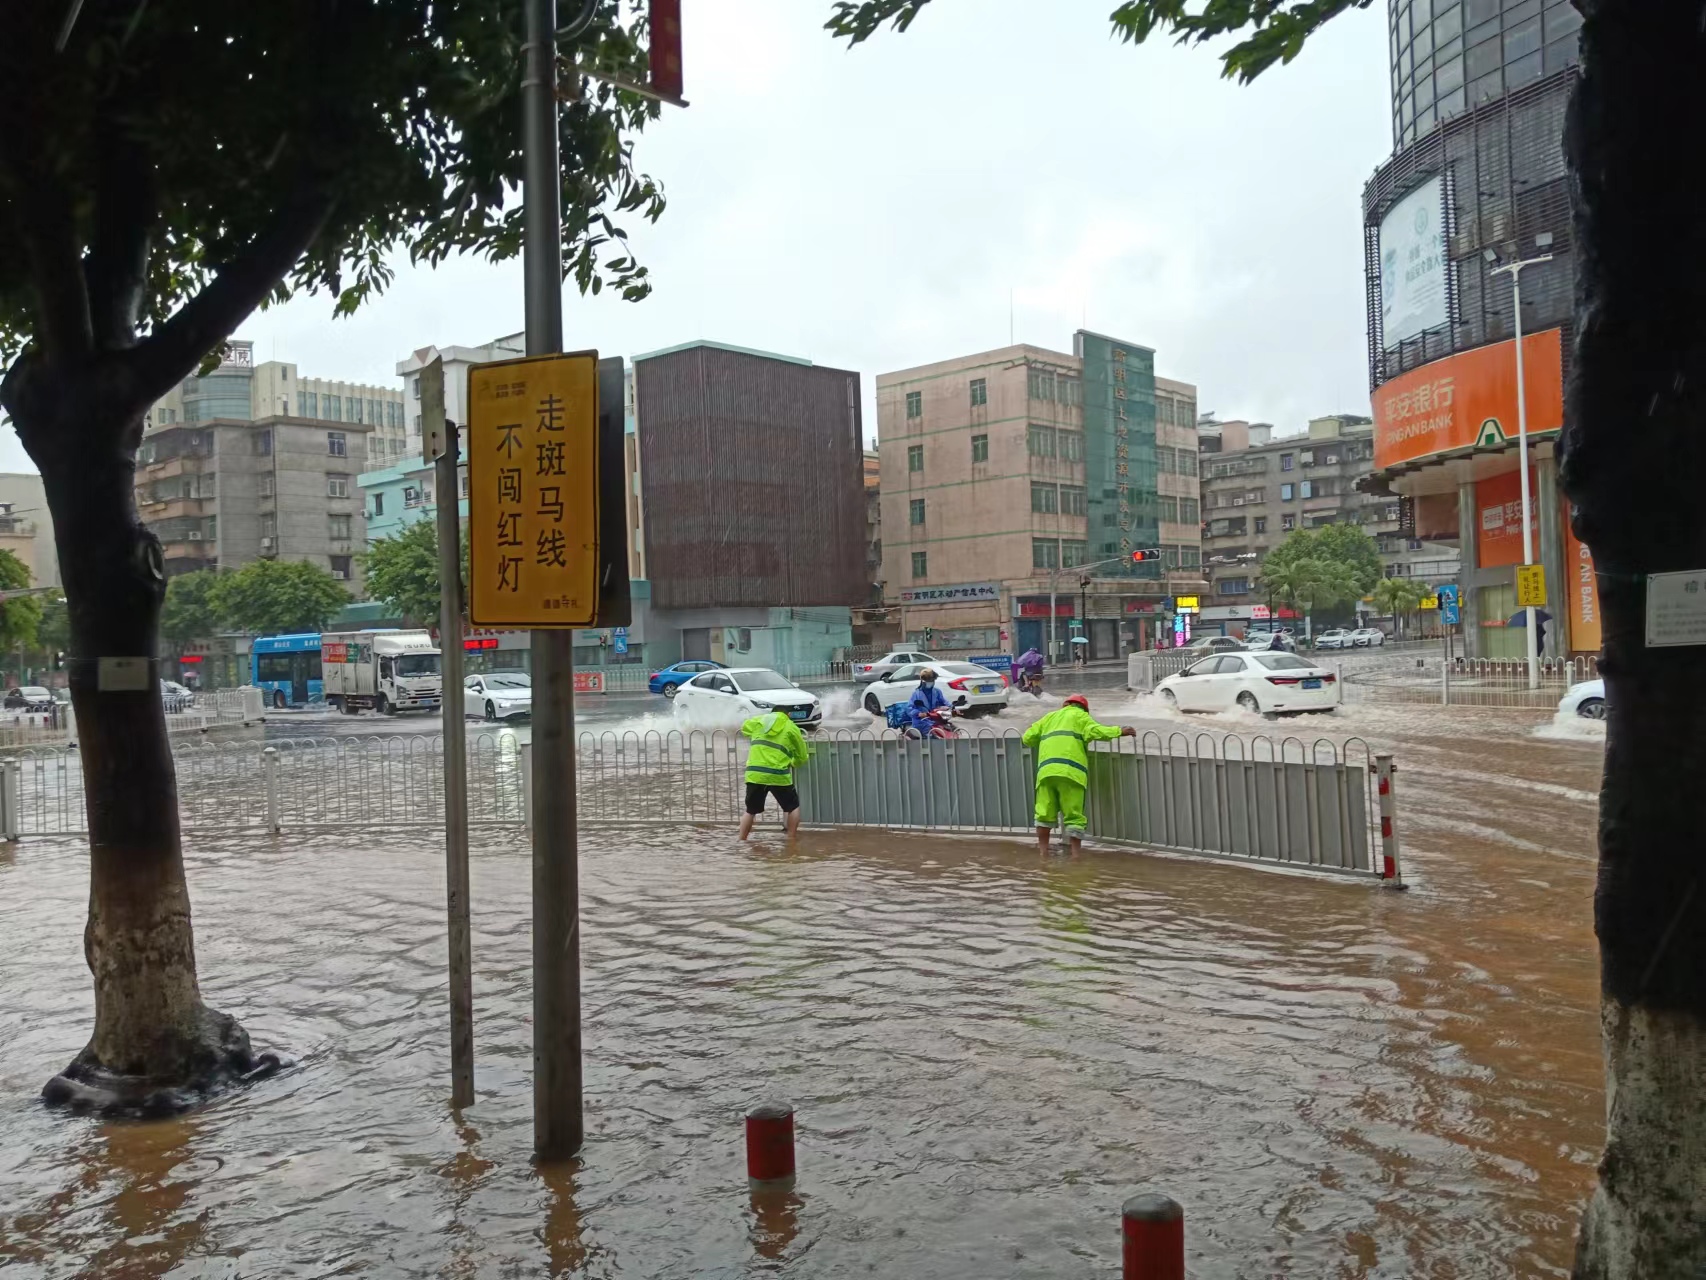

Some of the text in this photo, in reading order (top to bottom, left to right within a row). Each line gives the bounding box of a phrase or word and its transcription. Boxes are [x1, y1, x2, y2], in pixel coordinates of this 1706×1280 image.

[1384, 376, 1456, 424] 平安银行
[1421, 411, 1454, 434] BANK
[536, 393, 567, 568] 走斑马线
[496, 423, 524, 593] 不闯红灯
[1580, 563, 1592, 583] AN
[1581, 586, 1593, 623] BANK
